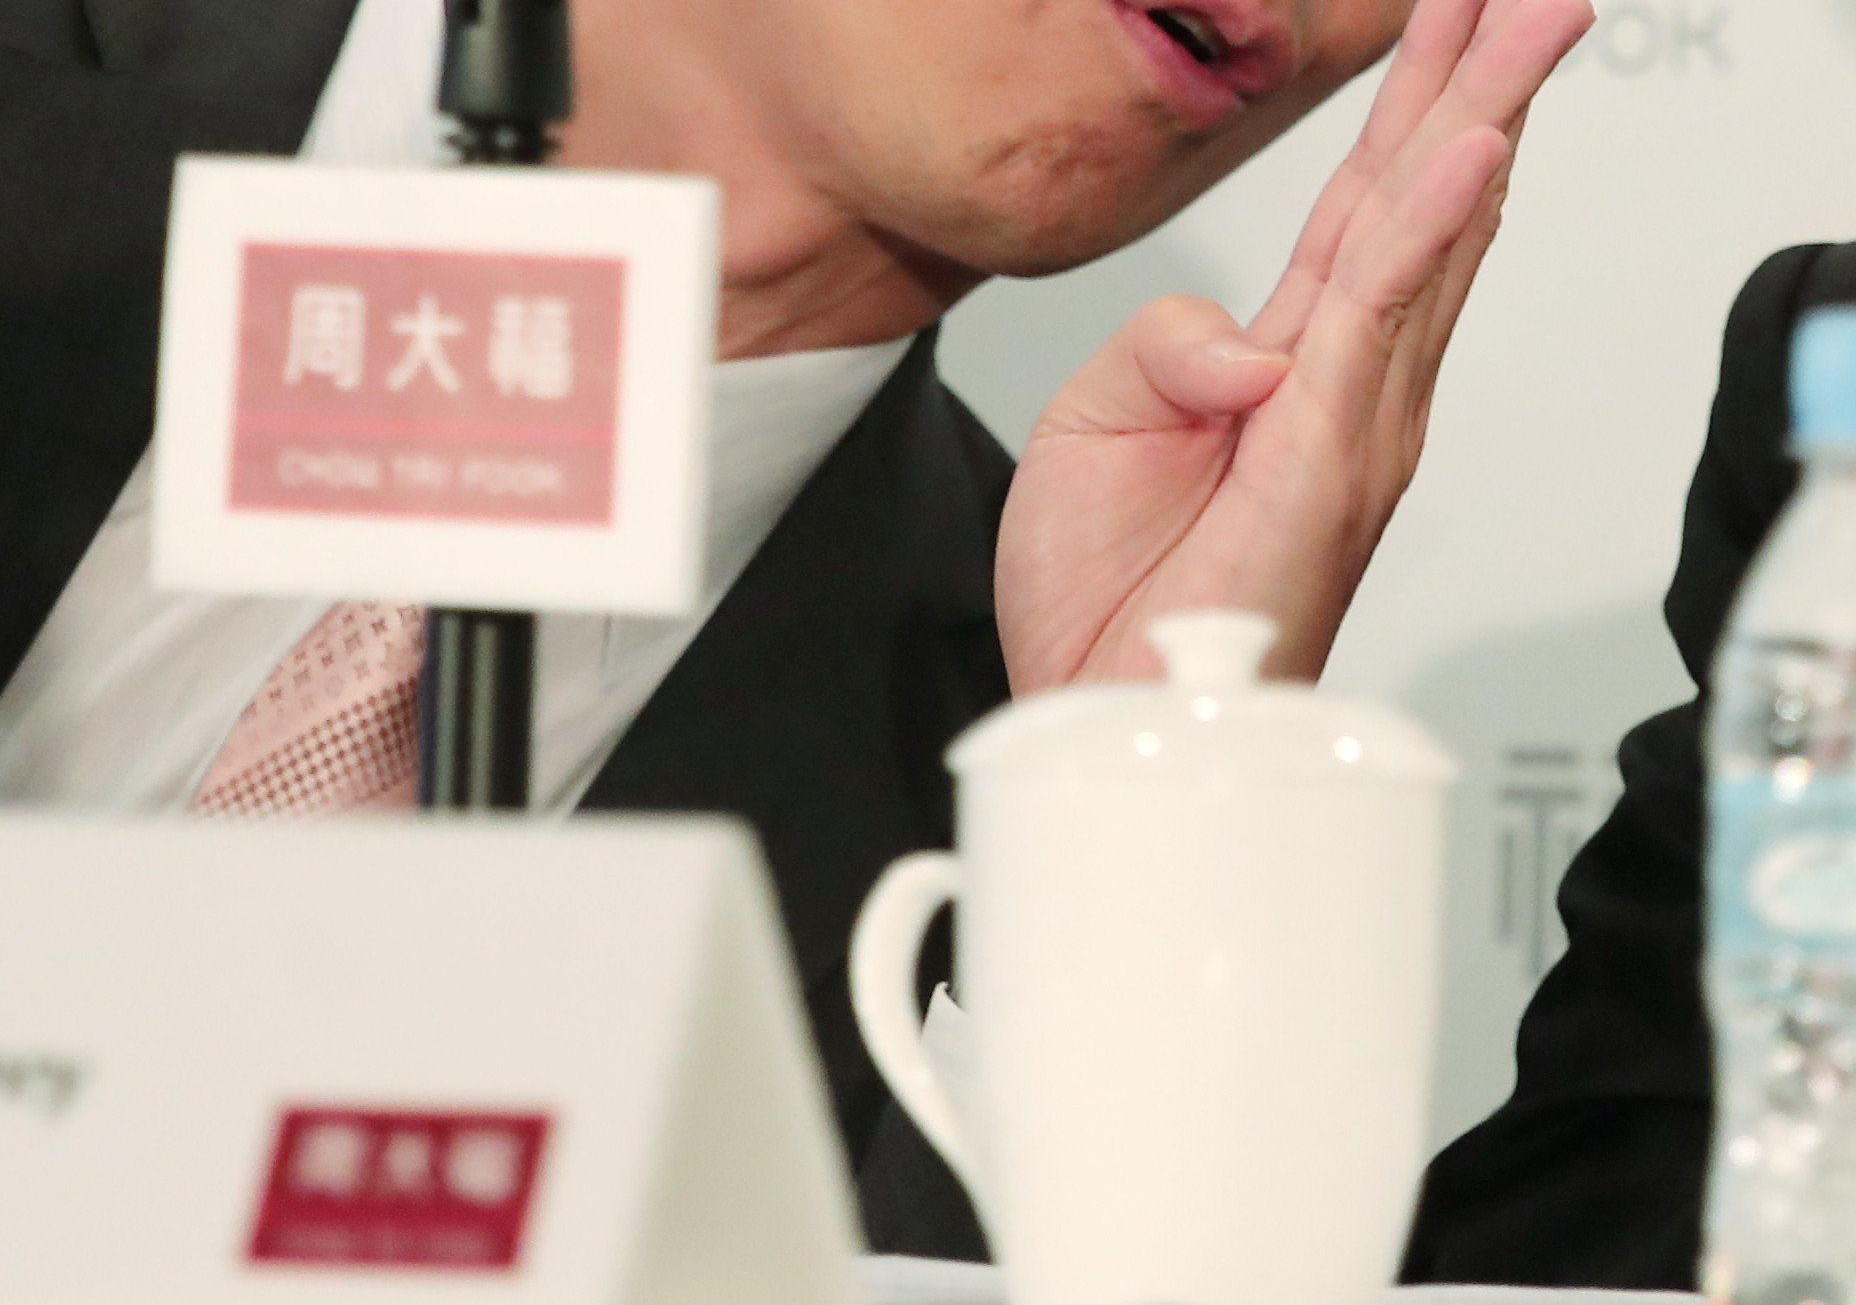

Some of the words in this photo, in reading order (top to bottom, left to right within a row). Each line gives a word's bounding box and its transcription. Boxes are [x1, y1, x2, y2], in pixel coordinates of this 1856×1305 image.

[1553, 0, 1733, 79] OK
[283, 283, 576, 399] 周大福
